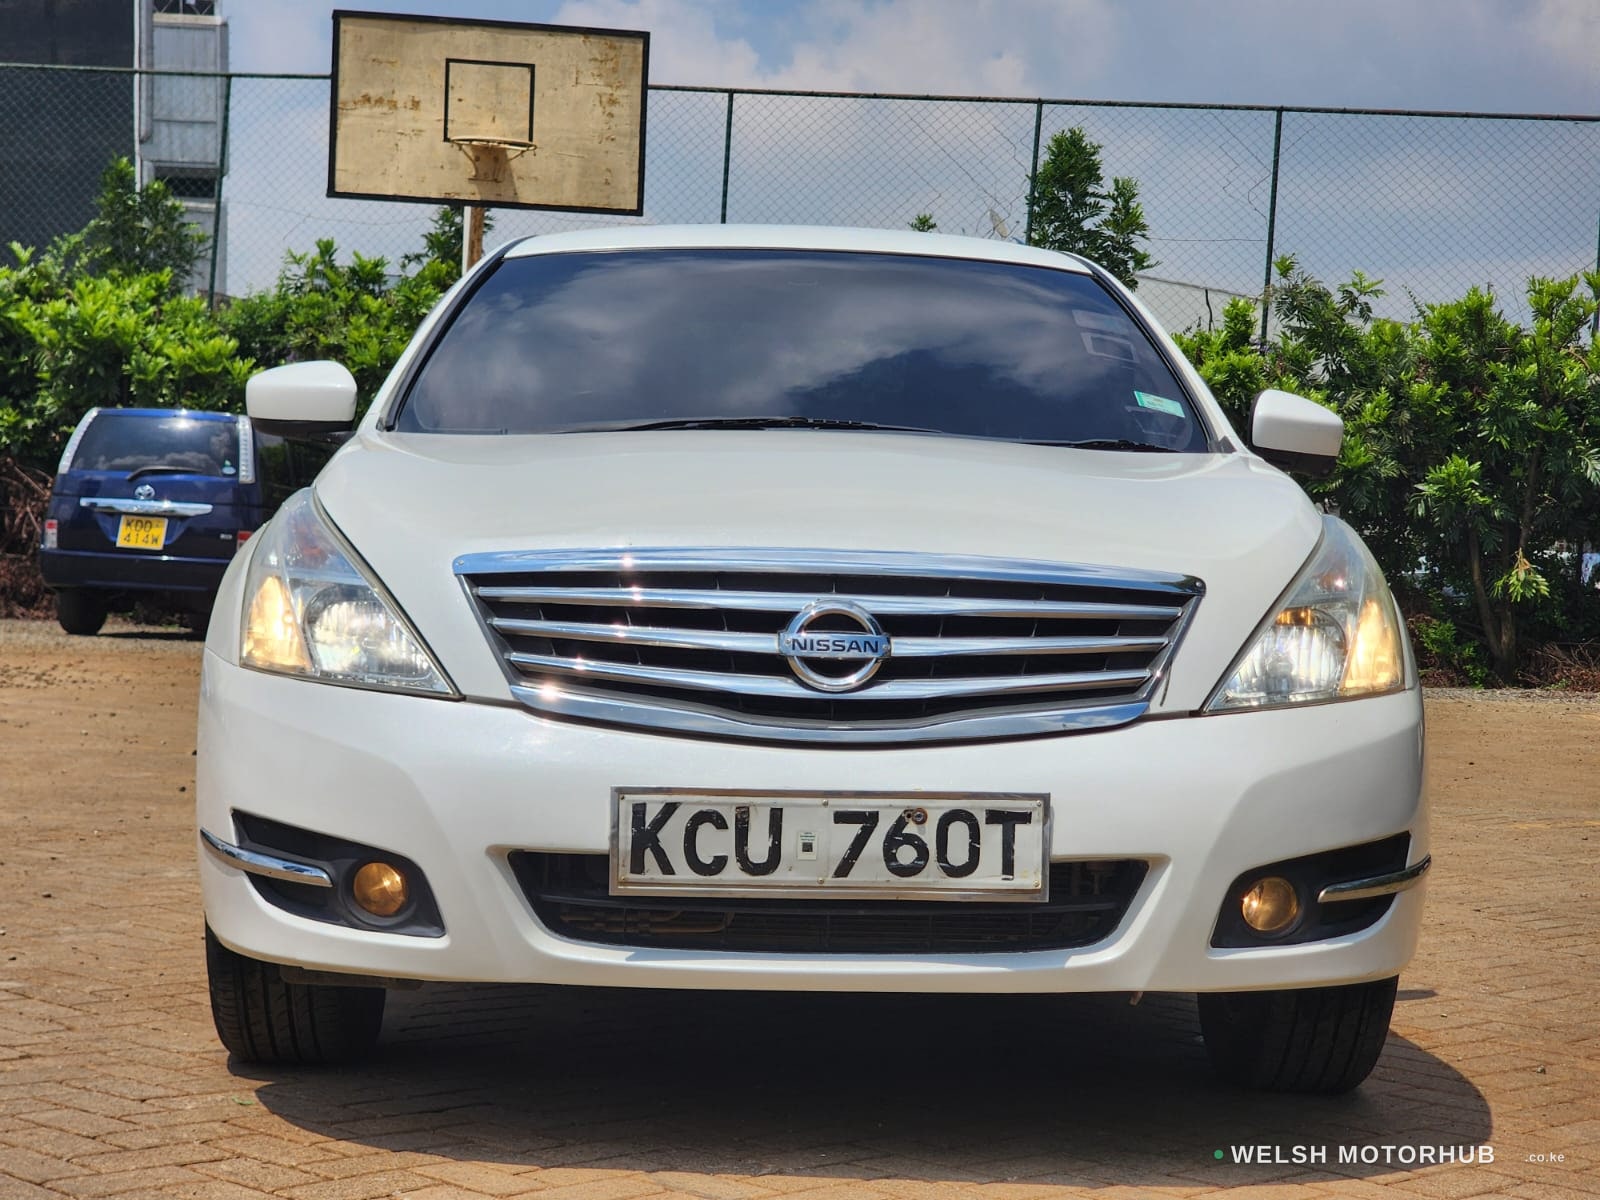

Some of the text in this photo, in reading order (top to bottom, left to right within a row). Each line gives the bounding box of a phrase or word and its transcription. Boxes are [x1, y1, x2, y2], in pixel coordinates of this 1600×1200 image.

[123, 533, 161, 545] 414W
[791, 638, 879, 653] NISSAN
[629, 801, 1033, 881] KCU 760T
